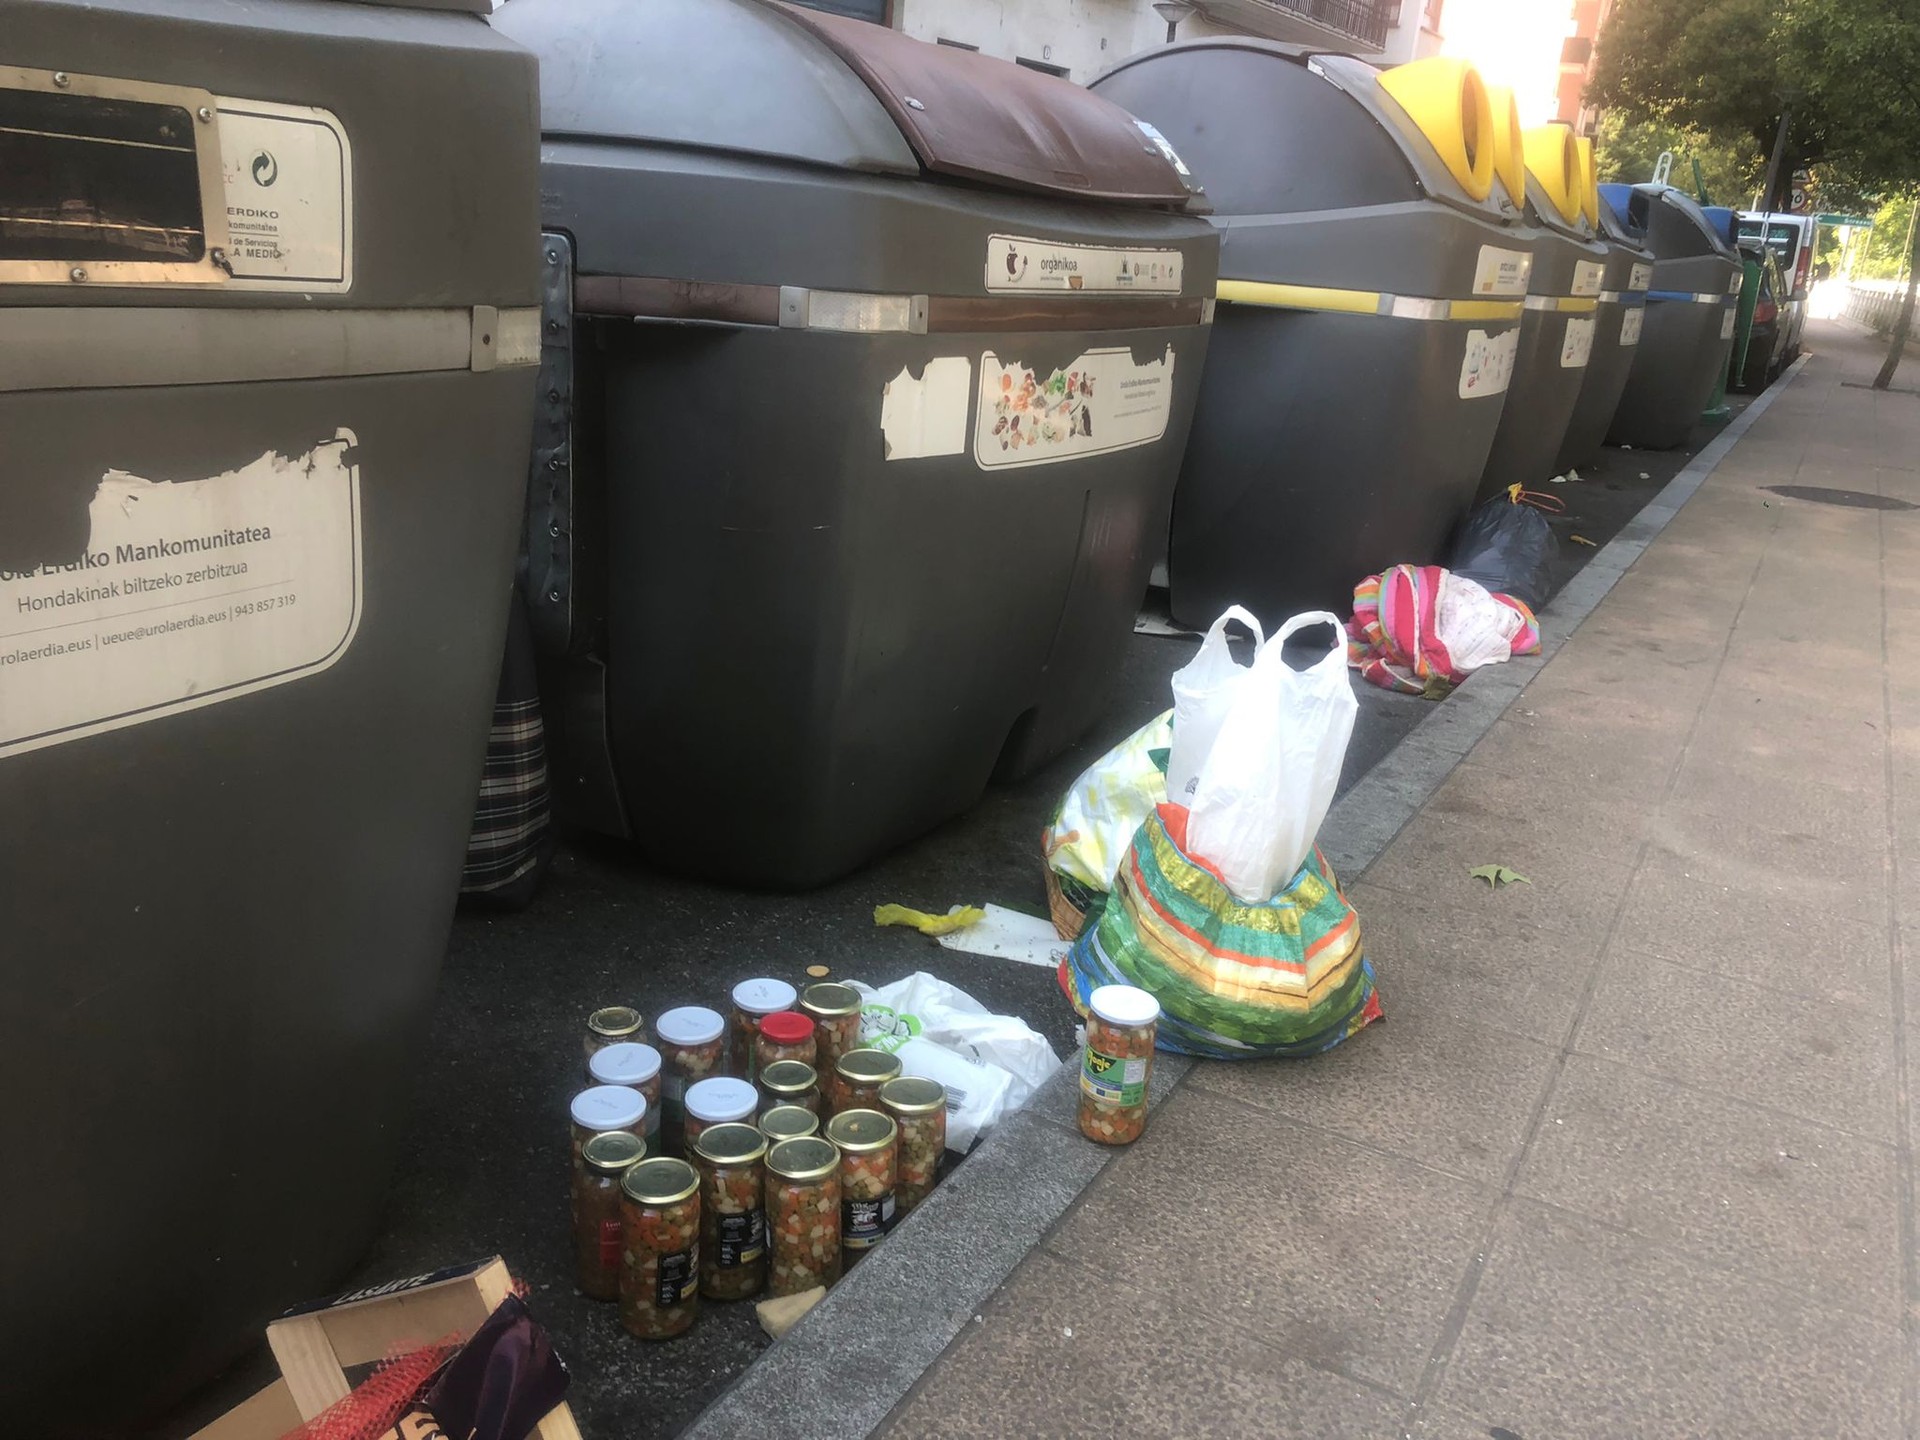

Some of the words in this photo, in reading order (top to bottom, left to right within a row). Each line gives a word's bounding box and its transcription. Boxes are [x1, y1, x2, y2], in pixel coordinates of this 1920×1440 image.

[226, 206, 279, 219] ERDIKO
[228, 220, 278, 232] komunitatea
[234, 238, 243, 246] de
[244, 238, 278, 248] Servicios
[1041, 257, 1078, 274] organikoa
[116, 526, 271, 565] Mankomunitatea
[17, 582, 120, 613] Hondakinak
[124, 572, 183, 595] biltzeko
[186, 562, 248, 584] zerbitzua
[102, 610, 227, 646] ueue@urolaerdia.eus
[235, 603, 255, 617] 943
[256, 598, 276, 612] 857
[277, 594, 296, 608] 319
